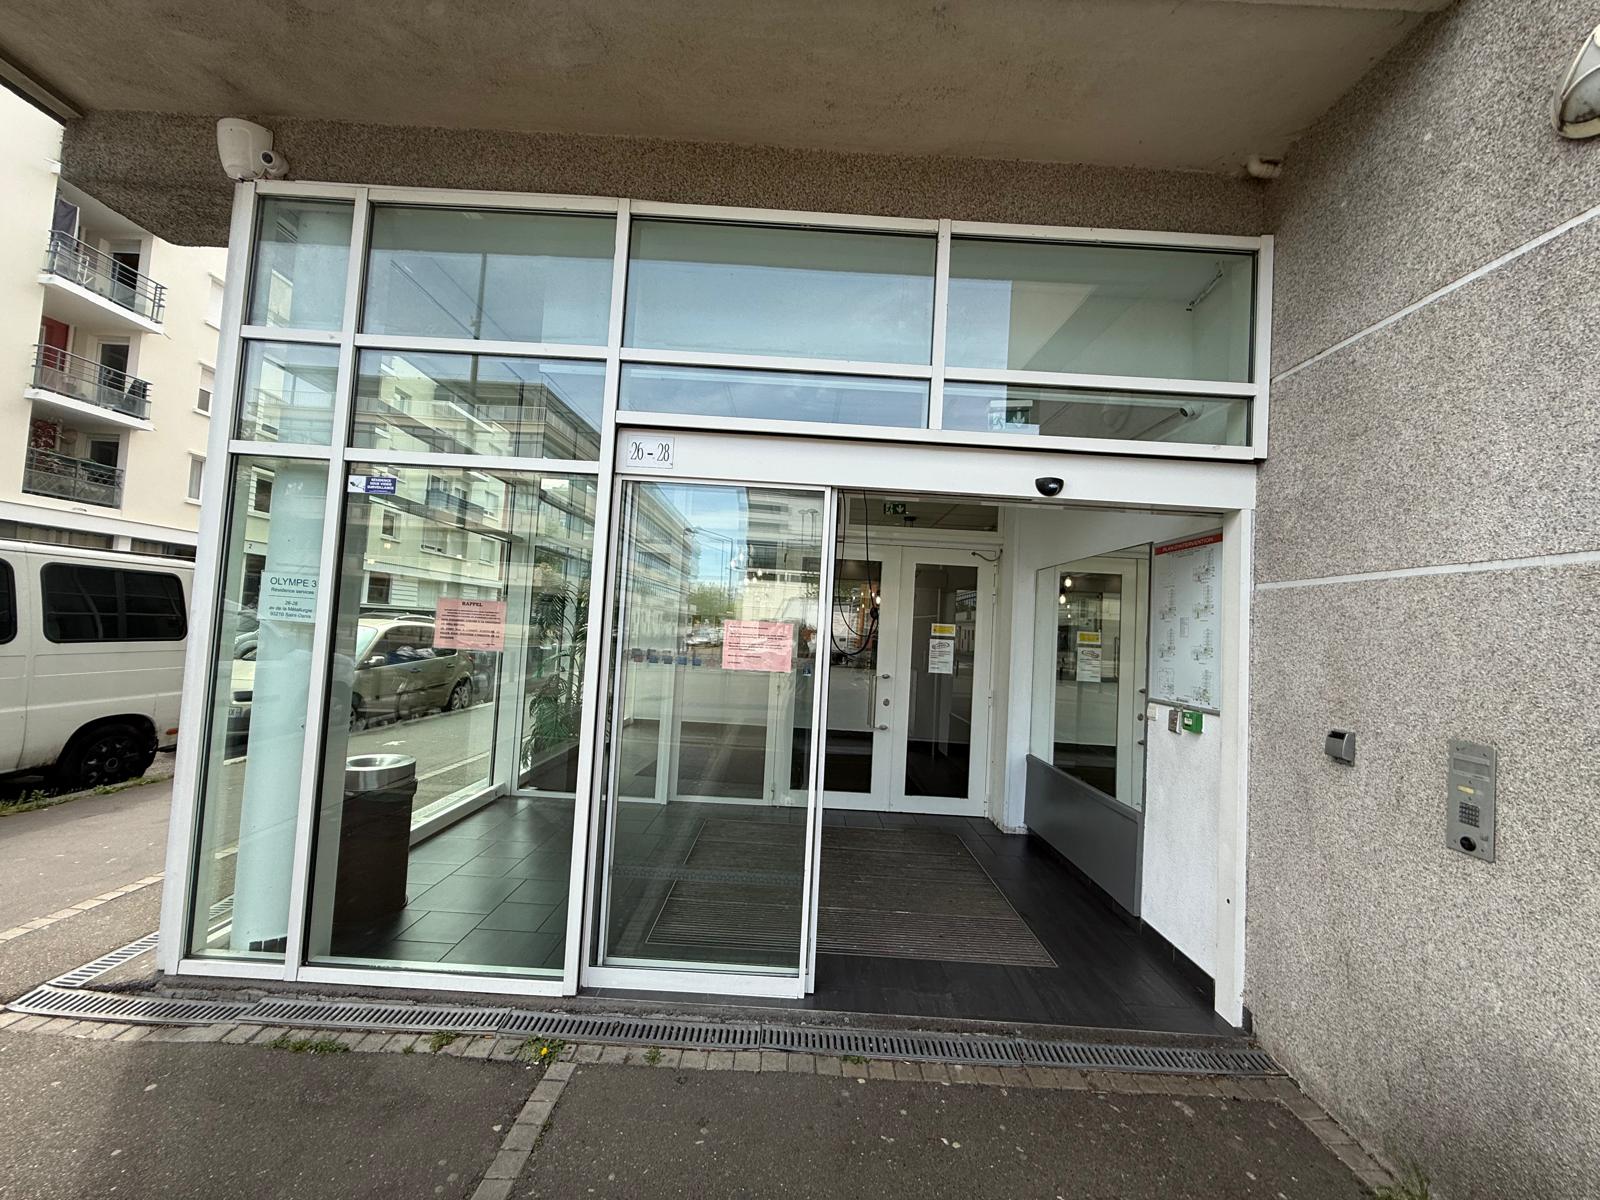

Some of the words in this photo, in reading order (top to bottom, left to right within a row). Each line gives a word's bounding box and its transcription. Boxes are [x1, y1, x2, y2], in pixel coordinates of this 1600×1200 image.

[630, 441, 644, 461] 26
[656, 442, 670, 462] 28
[270, 577, 308, 588] OLYMPE
[311, 579, 317, 588] 3
